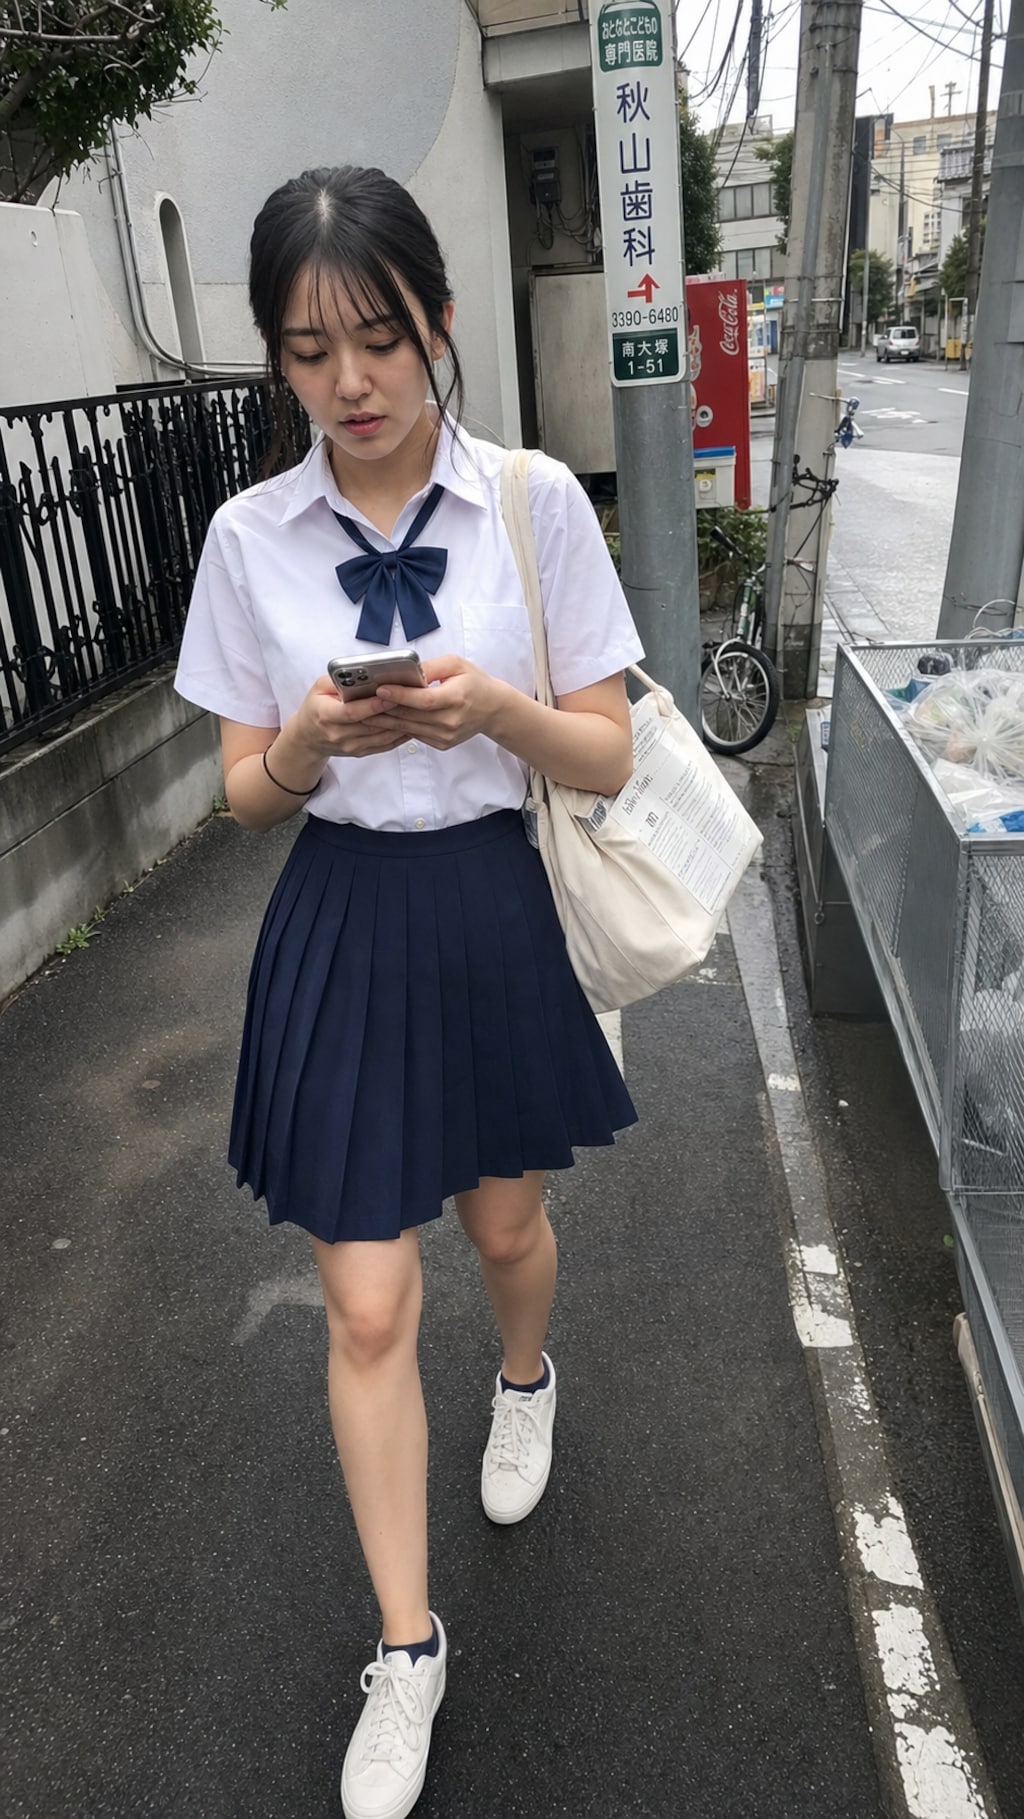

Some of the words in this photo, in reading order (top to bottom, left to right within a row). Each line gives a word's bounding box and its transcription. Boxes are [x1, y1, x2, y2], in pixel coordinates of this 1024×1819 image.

[602, 16, 658, 40] おとなとこどもの
[605, 40, 658, 66] 専門医院
[616, 80, 656, 267] 秋山歯科
[612, 306, 679, 328] 3390-6480
[622, 338, 669, 358] 南大塚
[628, 358, 663, 375] 1-51
